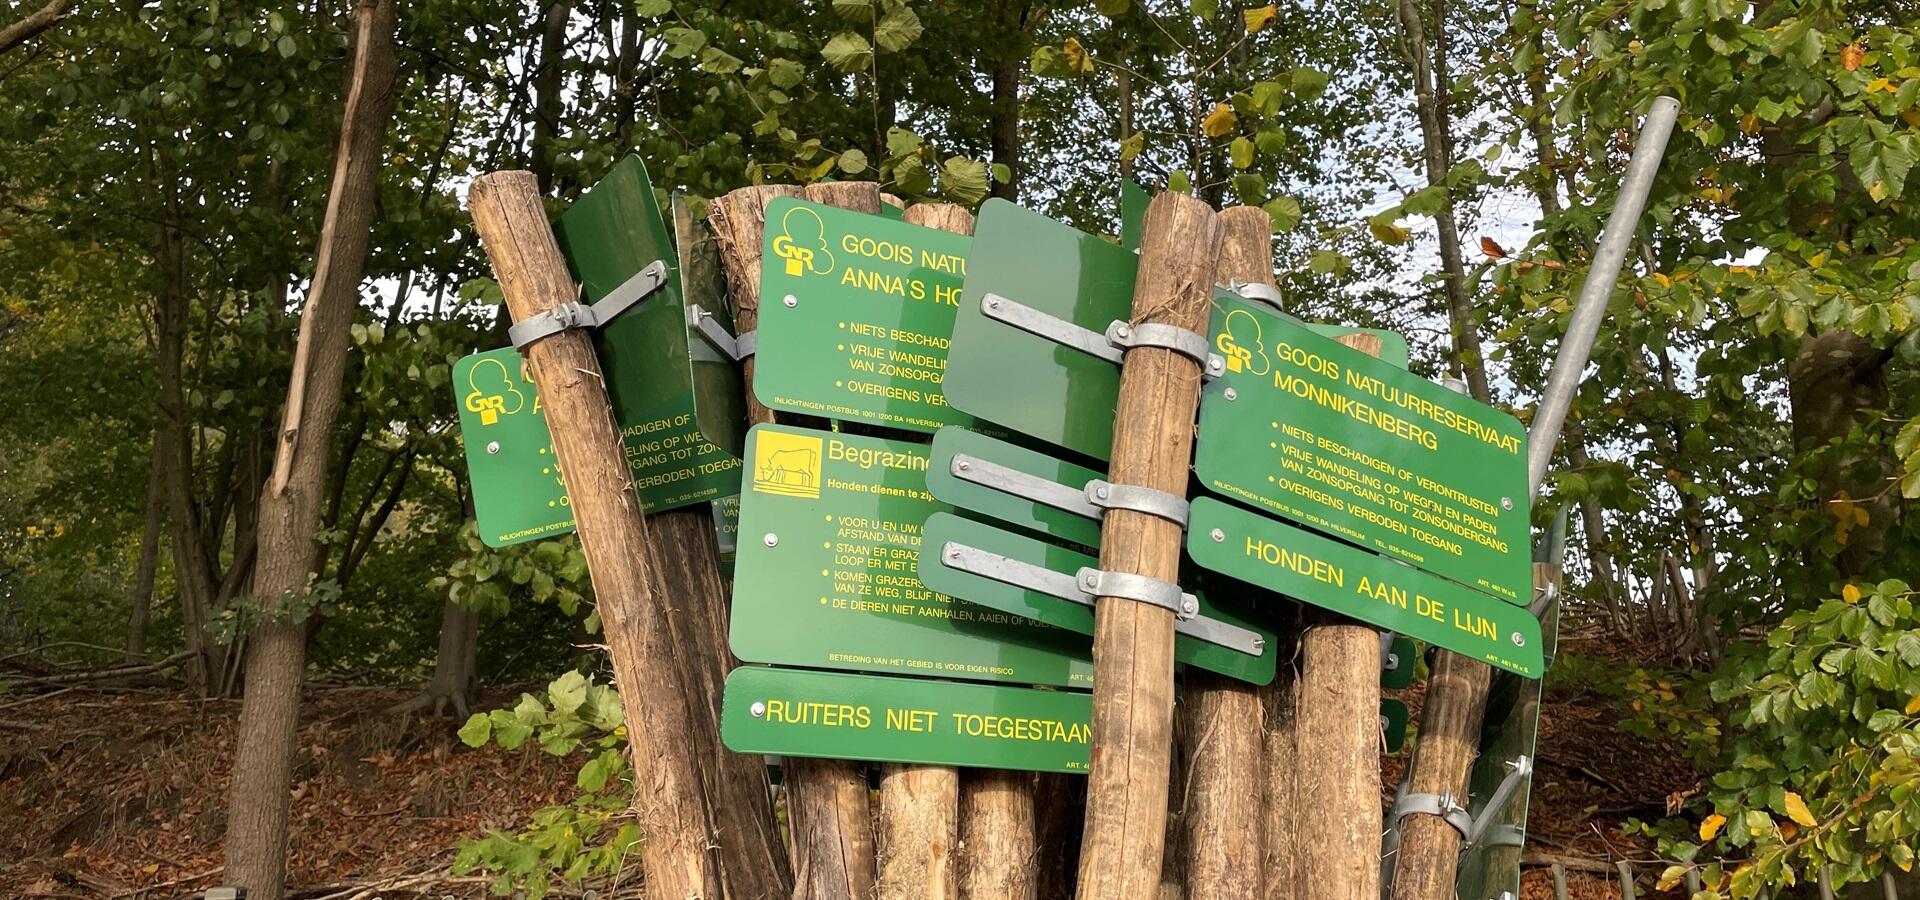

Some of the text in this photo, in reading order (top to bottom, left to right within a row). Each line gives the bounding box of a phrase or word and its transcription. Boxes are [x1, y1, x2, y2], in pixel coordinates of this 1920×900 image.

[773, 235, 814, 271] GNR
[842, 235, 913, 265] GOOIS
[841, 267, 925, 300] ANNA'S
[850, 322, 886, 338] NIETS
[850, 343, 885, 359] VRIJE
[1216, 333, 1252, 371] GNR
[849, 358, 874, 373] VAN
[465, 391, 507, 414] GNR
[847, 380, 920, 403] OVERIGENS
[1276, 342, 1522, 456] GOOIS NATUURRESERVAAT
[674, 414, 691, 427] OF
[774, 397, 944, 429] INLICHTINGEN POSTBUS 1001 1200 BA HILVERSUM
[1273, 370, 1439, 451] MONNIKENBERG
[663, 436, 680, 449] OP
[670, 447, 693, 461] TOT
[1282, 423, 1499, 517] NIETS BESCHADIGEN OF VERONTRUSTEN
[827, 479, 868, 492] Honden
[870, 484, 905, 497] dienen
[908, 489, 918, 499] te
[1281, 443, 1498, 536] VRIJE WANDELING OP WEGEN EN PADEN
[1214, 480, 1259, 501] INLICHTINGEN
[1260, 497, 1290, 513] POSTBUS
[1320, 518, 1330, 527] BA
[1331, 523, 1366, 541] HILVERSUM
[1278, 477, 1463, 557] OVERIGENS VERBODEN TOEGANG
[1281, 457, 1508, 554] VAN ZONSOPGANG TOT ZONSONDERGANG
[499, 527, 544, 542] INLICHTINGEN
[837, 516, 868, 531] VOOR
[871, 520, 880, 530] U
[883, 521, 897, 531] EN
[900, 522, 918, 534] UW
[837, 528, 885, 543] AFSTAND
[887, 534, 908, 545] VAN
[836, 543, 870, 556] STAAN
[873, 547, 888, 558] ER
[835, 555, 864, 567] LOOP
[867, 558, 882, 569] ER
[885, 559, 907, 571] MET
[834, 571, 873, 584] KOMEN
[1245, 536, 1497, 642] HONDEN AAN DE LIJN
[834, 582, 856, 594] VAN
[858, 585, 873, 595] ZE
[905, 589, 932, 601] BLIJF
[832, 598, 846, 610] DE
[850, 600, 889, 613] DIEREN
[892, 604, 916, 616] NIET
[917, 606, 976, 623] AANHALEN,
[978, 613, 1009, 625] AAIEN
[829, 653, 1014, 676] BETREDING VAN HET GEBIED IS VOOR EIGEN RISICO
[766, 700, 871, 729] RUITERS
[886, 708, 938, 733] NIET
